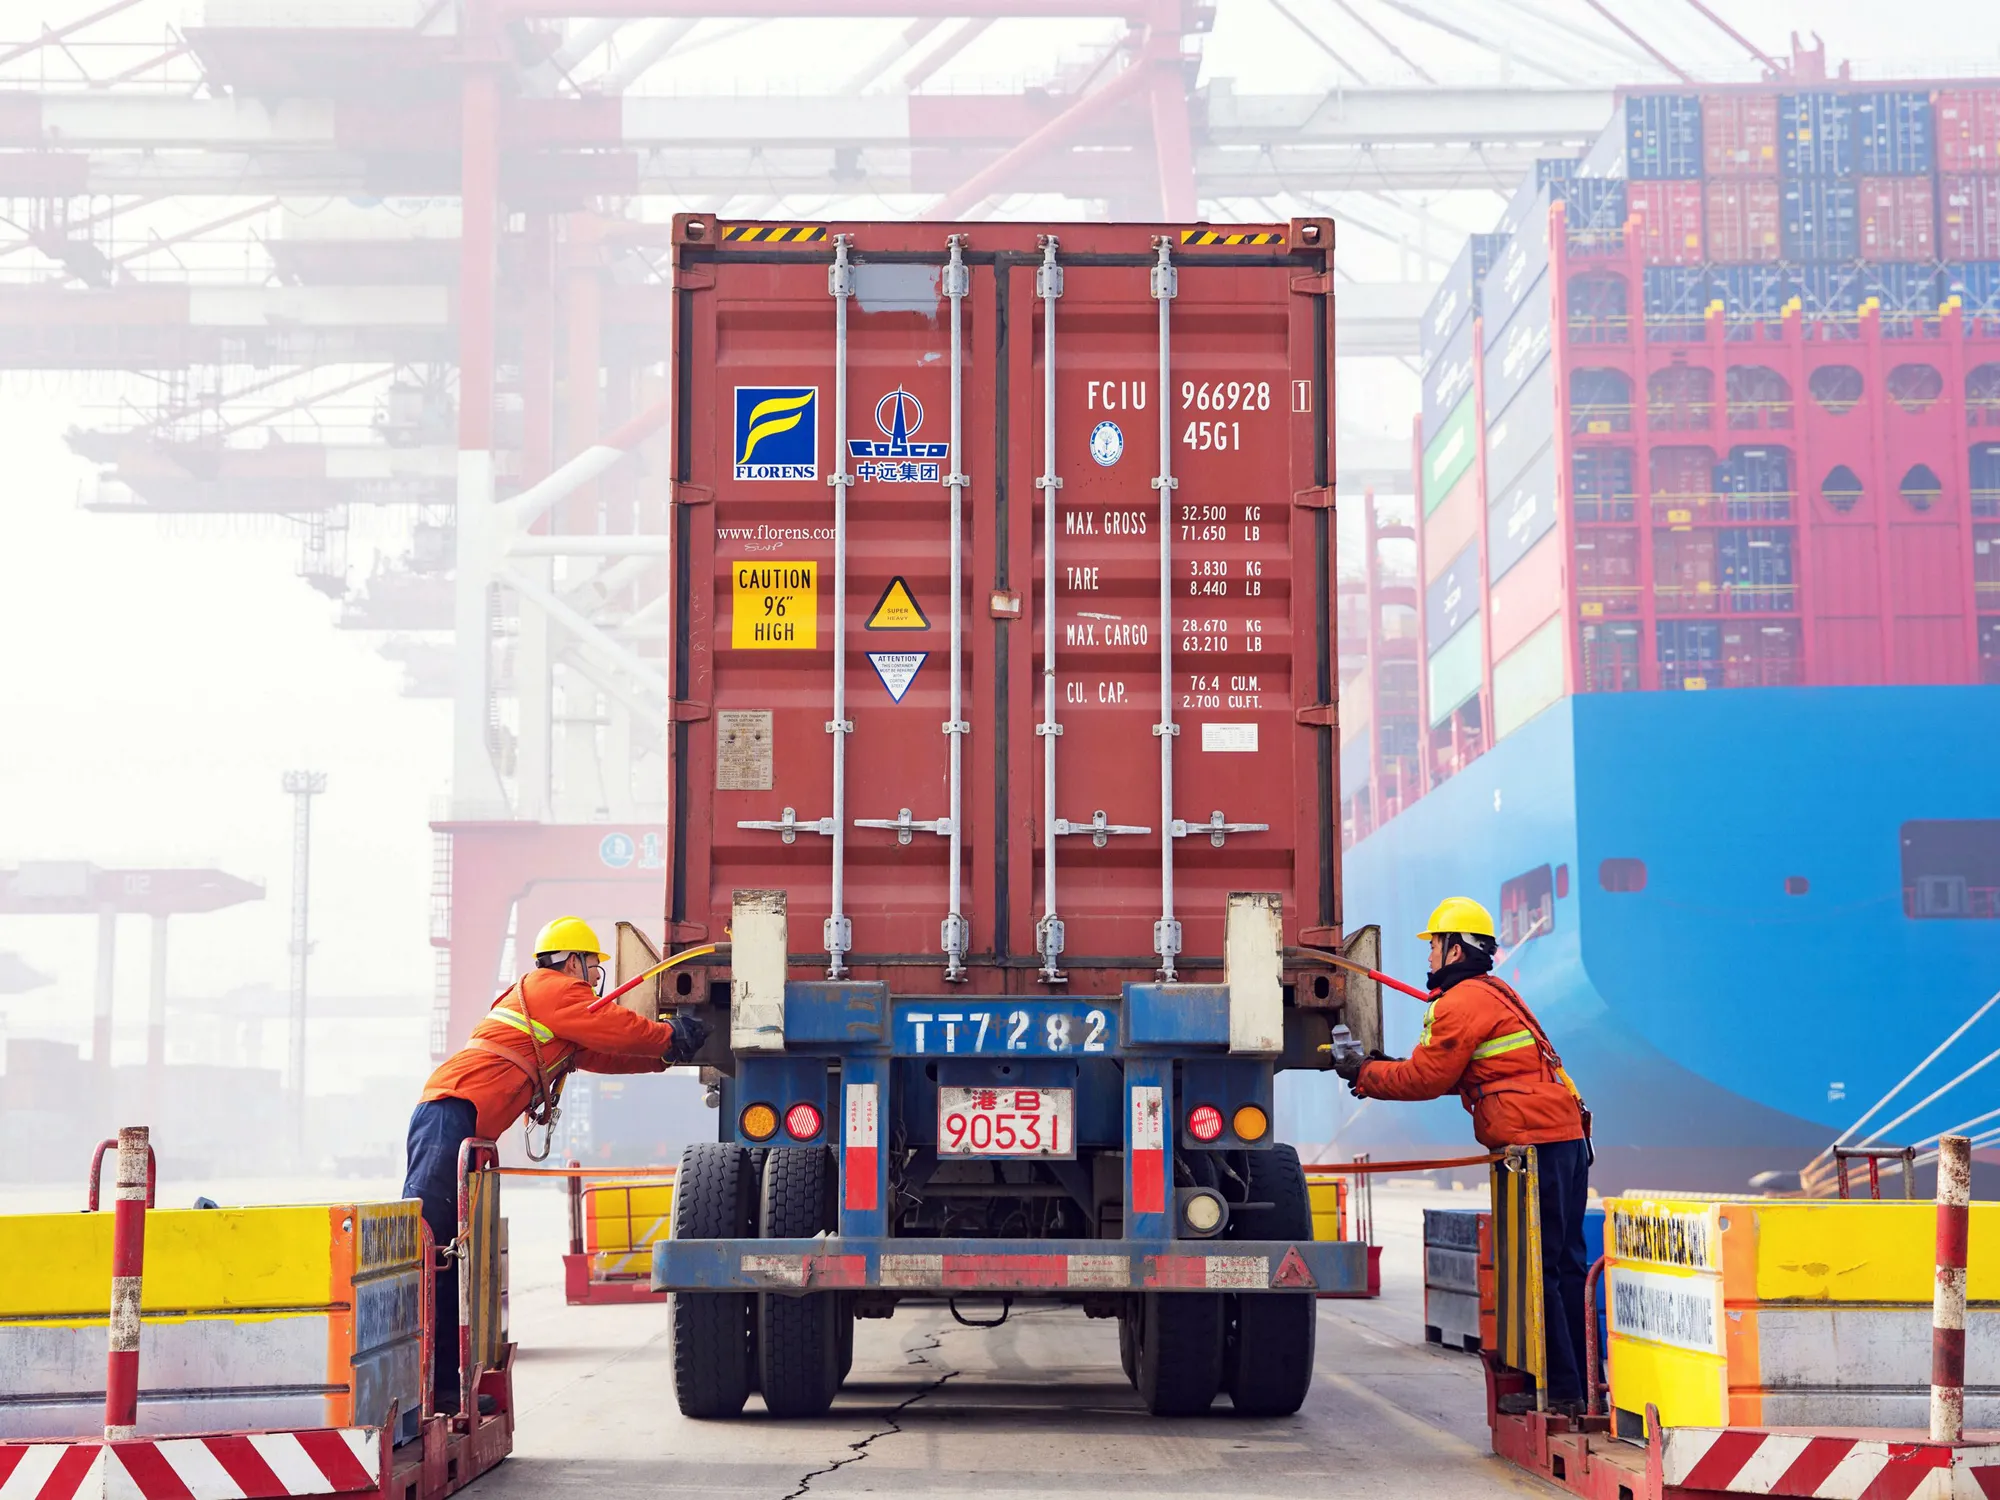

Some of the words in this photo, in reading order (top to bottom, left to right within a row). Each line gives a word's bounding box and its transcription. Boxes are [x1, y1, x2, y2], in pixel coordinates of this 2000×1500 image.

[1088, 381, 1147, 410] FCIU
[1182, 381, 1270, 411] 966928
[1298, 382, 1306, 410] 1
[1183, 421, 1240, 450] 45G1
[736, 466, 815, 479] FLORENS
[857, 461, 940, 483] 中远集团
[1066, 511, 1099, 535] MAX.
[1104, 511, 1147, 535] GROSS
[1245, 506, 1261, 521] KG
[1245, 526, 1260, 541] LB
[739, 569, 811, 589] CAUTION
[1067, 567, 1099, 590] TARE
[1246, 561, 1262, 576] KG
[1246, 581, 1261, 596] LB
[755, 623, 794, 641] HIGH
[1067, 624, 1099, 646] MAX.
[1105, 624, 1148, 646] CARGO
[1246, 620, 1262, 632] KG
[1247, 637, 1262, 652] LB
[1067, 682, 1087, 703] CU.
[1099, 682, 1128, 703] CAP.
[1191, 676, 1219, 691] 76.4
[1231, 676, 1262, 691] CU.M.
[1228, 695, 1263, 708] CU.FT.
[946, 1113, 1058, 1150] 90531
